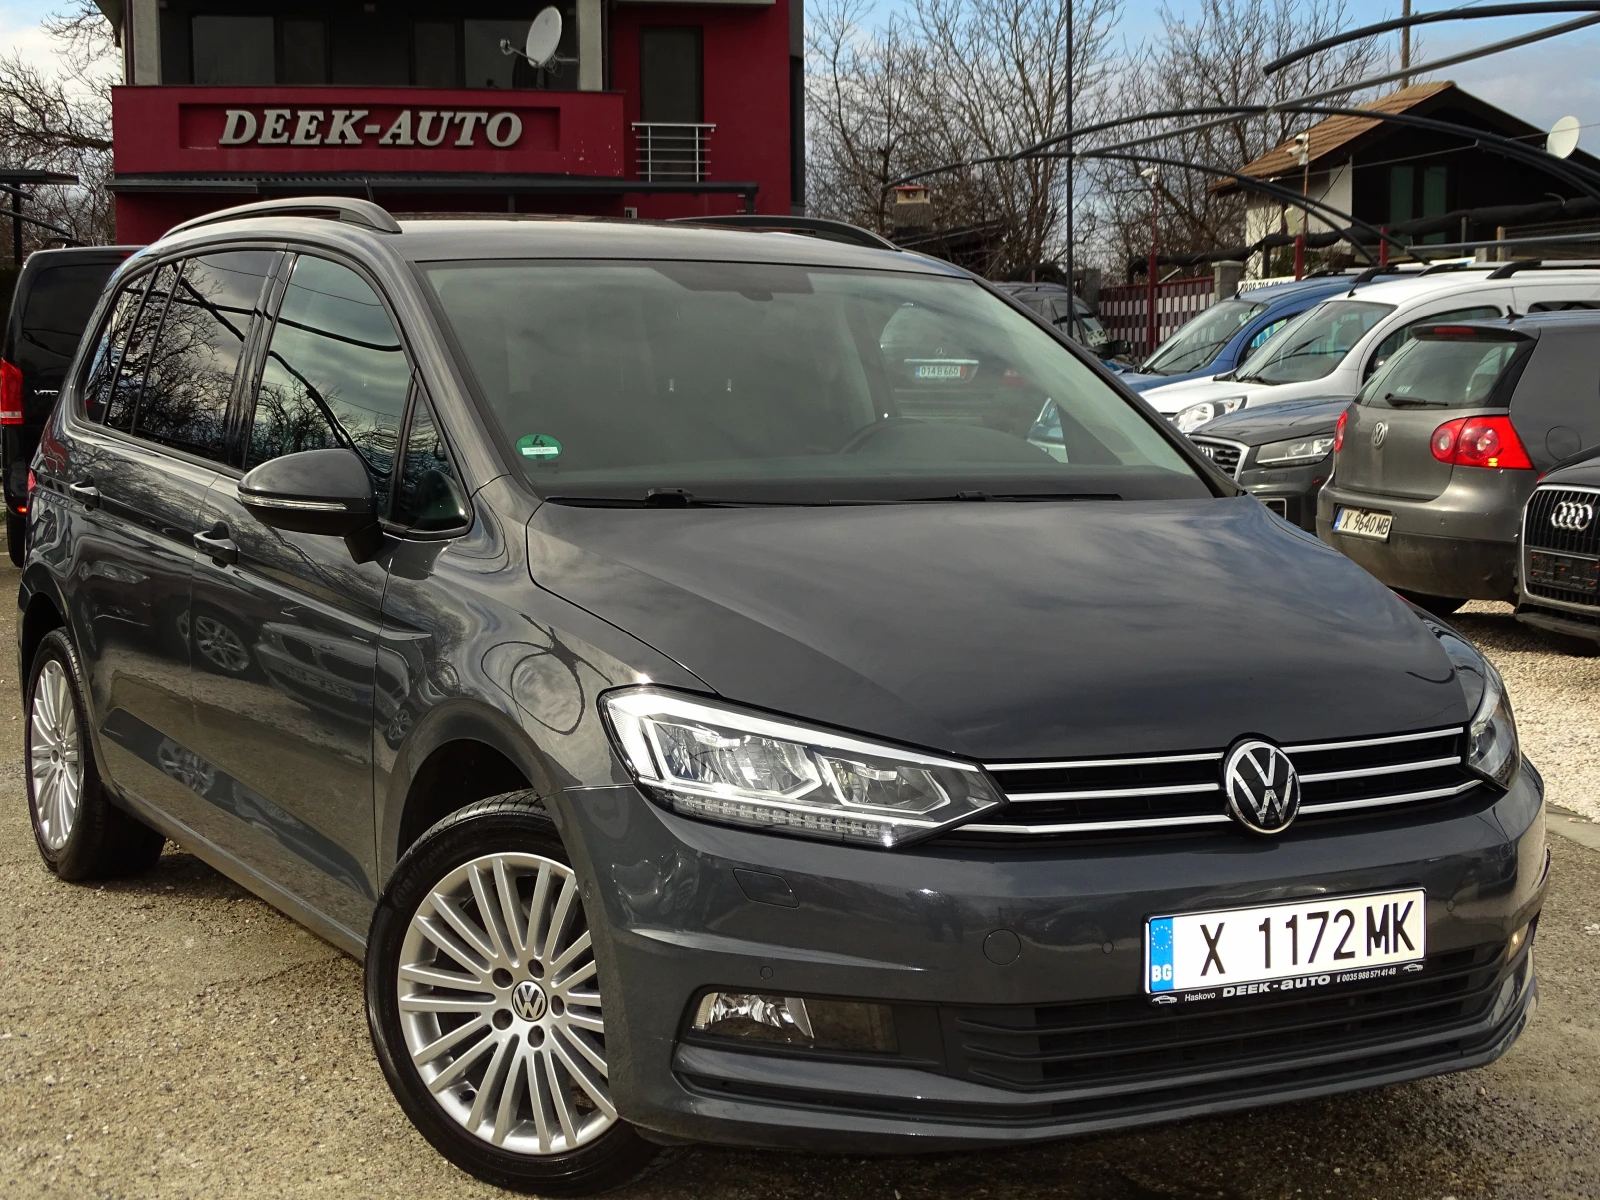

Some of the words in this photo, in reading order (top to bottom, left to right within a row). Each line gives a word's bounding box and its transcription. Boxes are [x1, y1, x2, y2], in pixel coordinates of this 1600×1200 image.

[219, 109, 523, 147] DEEK-AUTO
[1342, 511, 1353, 529] X
[1200, 922, 1226, 976] X
[1258, 909, 1356, 969] 1172
[1366, 900, 1416, 957] MK
[1151, 964, 1173, 982] BG
[1184, 991, 1216, 1002] Haskovo
